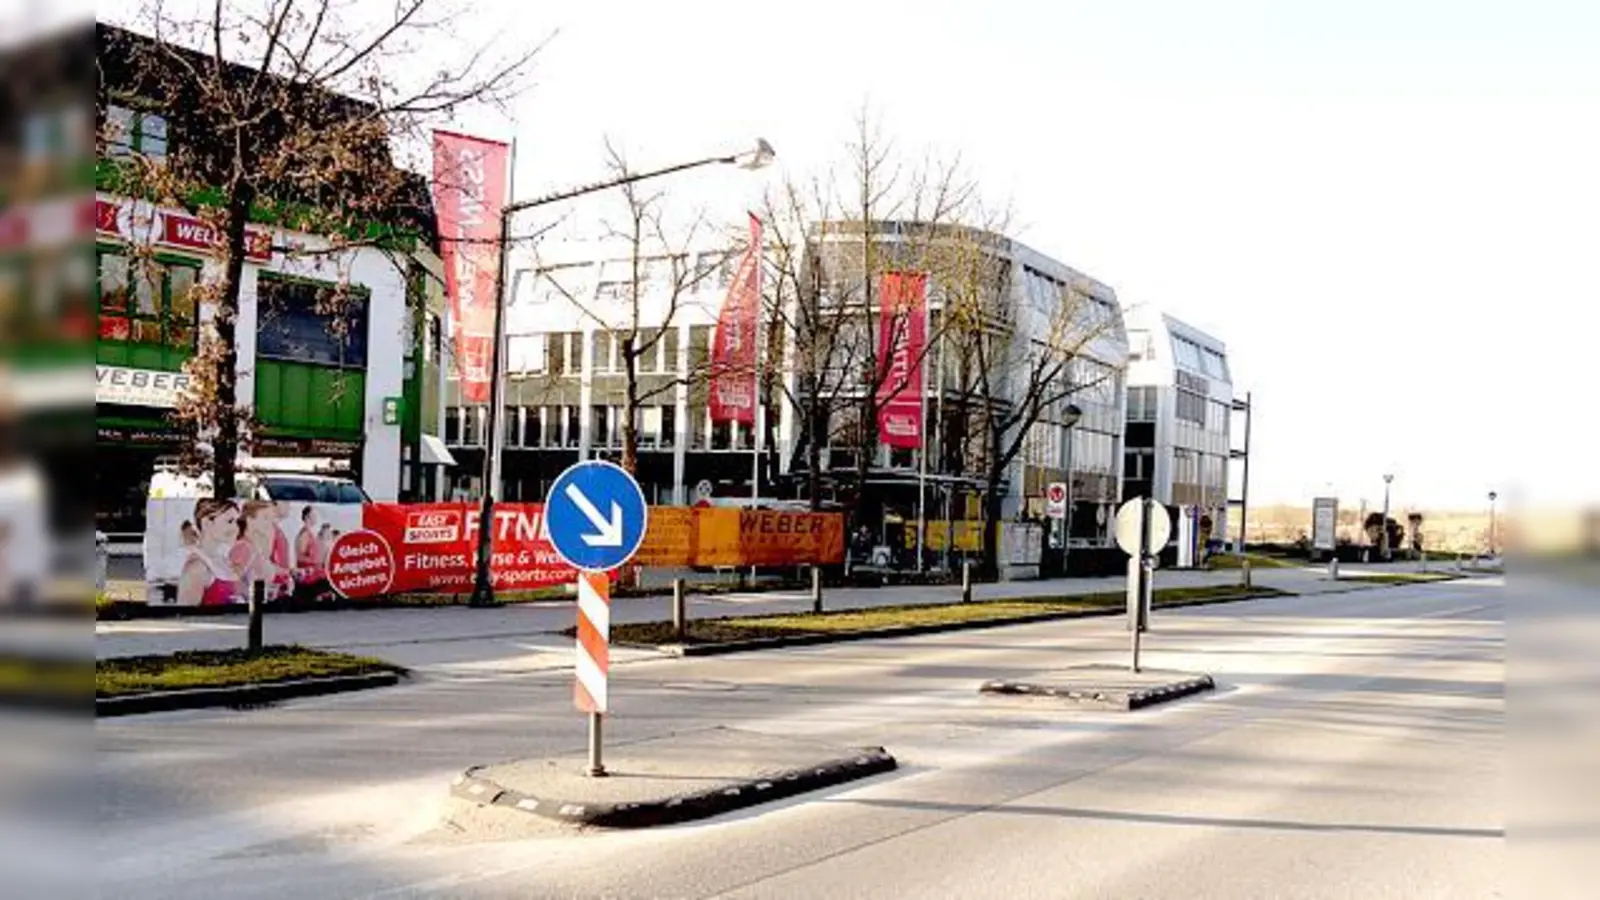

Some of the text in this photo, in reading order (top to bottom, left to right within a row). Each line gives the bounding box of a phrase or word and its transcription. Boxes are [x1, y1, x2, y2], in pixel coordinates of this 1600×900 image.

[418, 513, 447, 528] EASY
[740, 510, 824, 534] WEBER
[408, 528, 453, 541] SPORTS
[338, 542, 379, 559] Gleich
[332, 555, 388, 575] Angebot
[404, 551, 469, 572] Fitness,
[517, 549, 529, 567] &
